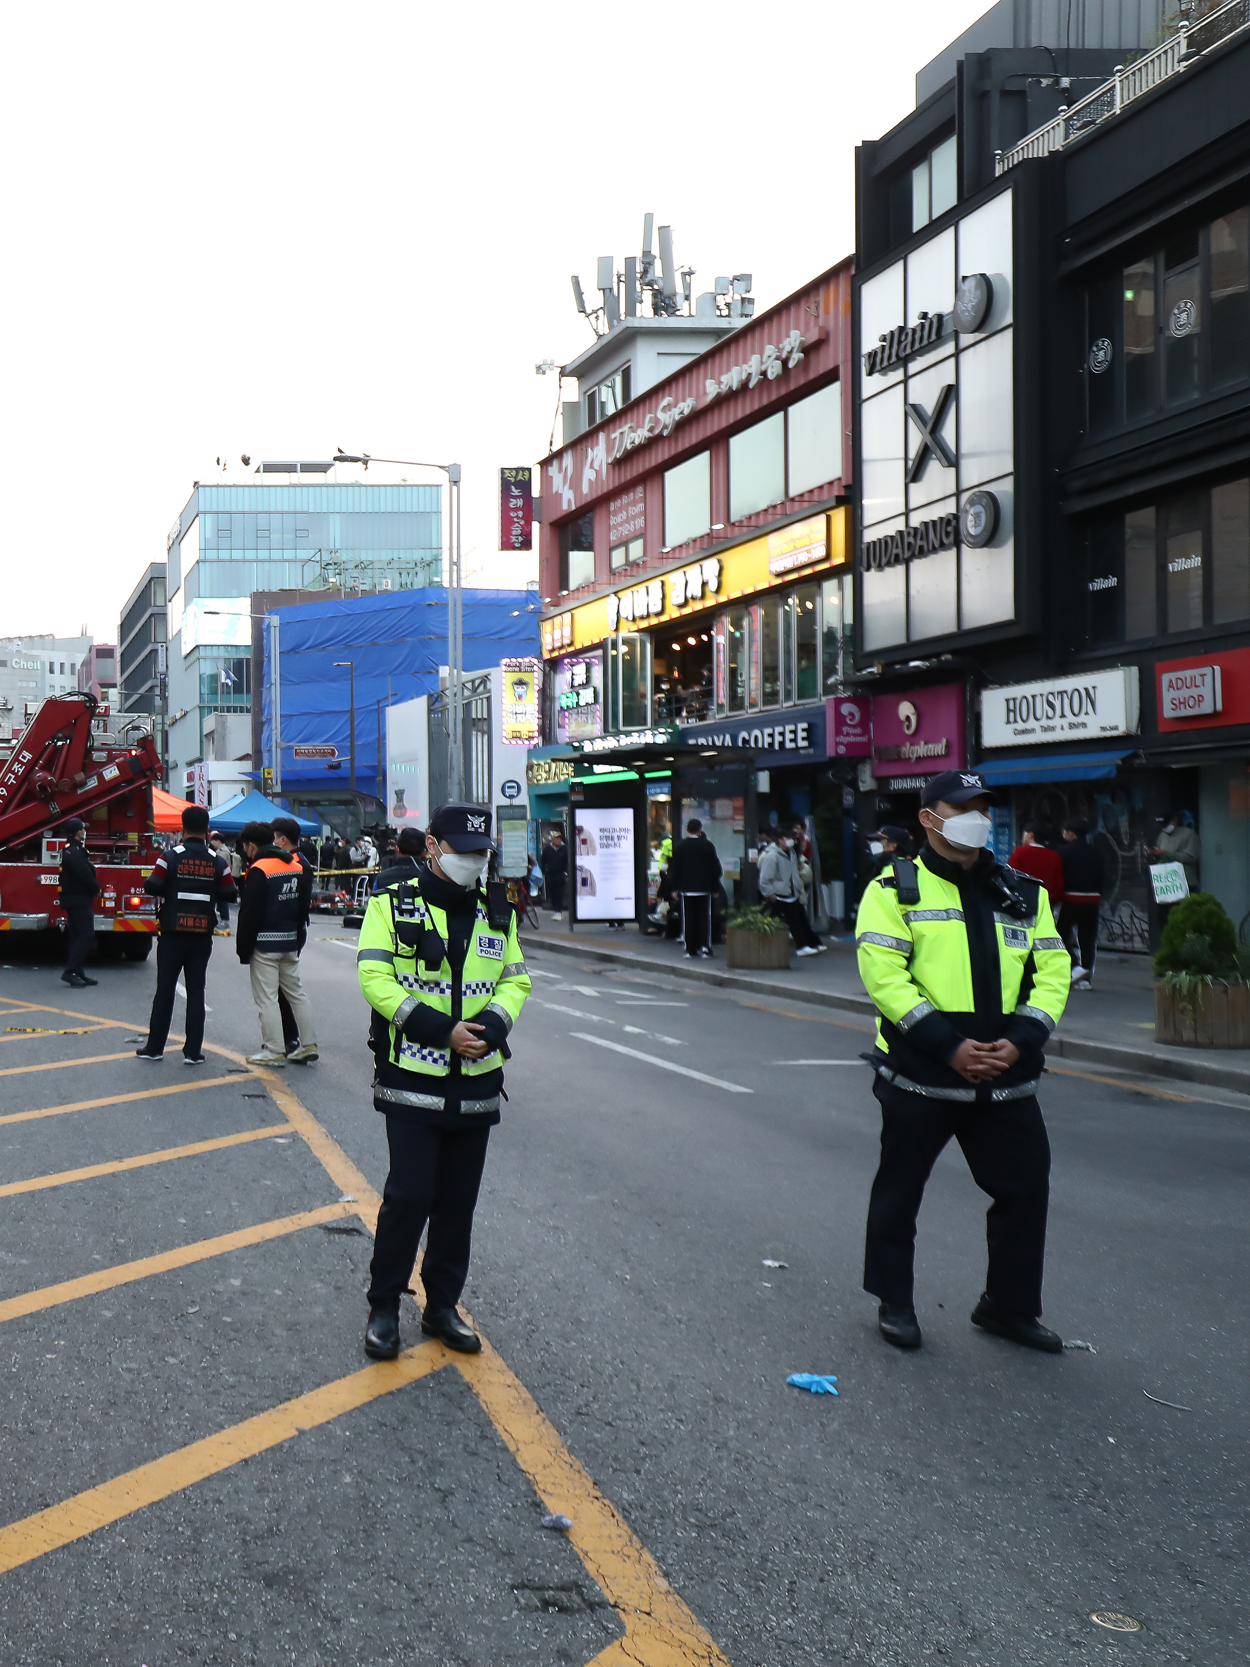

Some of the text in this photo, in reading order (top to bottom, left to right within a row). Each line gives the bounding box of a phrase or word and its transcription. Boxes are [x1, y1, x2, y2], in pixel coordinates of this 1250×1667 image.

[862, 312, 944, 376] villain
[705, 330, 806, 402] 노래연습장
[905, 384, 956, 483] X
[503, 468, 530, 482] 적셔
[509, 485, 524, 548] 노래연습장
[861, 513, 958, 572] JUDABANG
[1168, 554, 1202, 573] villain
[669, 558, 722, 606] 감자탕
[1088, 575, 1118, 591] villain
[12, 658, 40, 670] Cheil
[1167, 673, 1207, 692] ADULT
[506, 704, 536, 713] 이바돔
[1004, 686, 1098, 725] HOUSTON
[1170, 694, 1205, 711] SHOP
[688, 733, 733, 747] IYA
[738, 722, 809, 750] COFFEE
[1013, 728, 1036, 736] Custom
[1040, 725, 1057, 733] Tailor
[1068, 722, 1088, 730] Shirts
[836, 736, 869, 744] elephant
[901, 737, 948, 763] elephant
[890, 778, 926, 790] JUDABANG
[179, 917, 208, 928] 서울소방
[479, 949, 502, 957] POLICE
